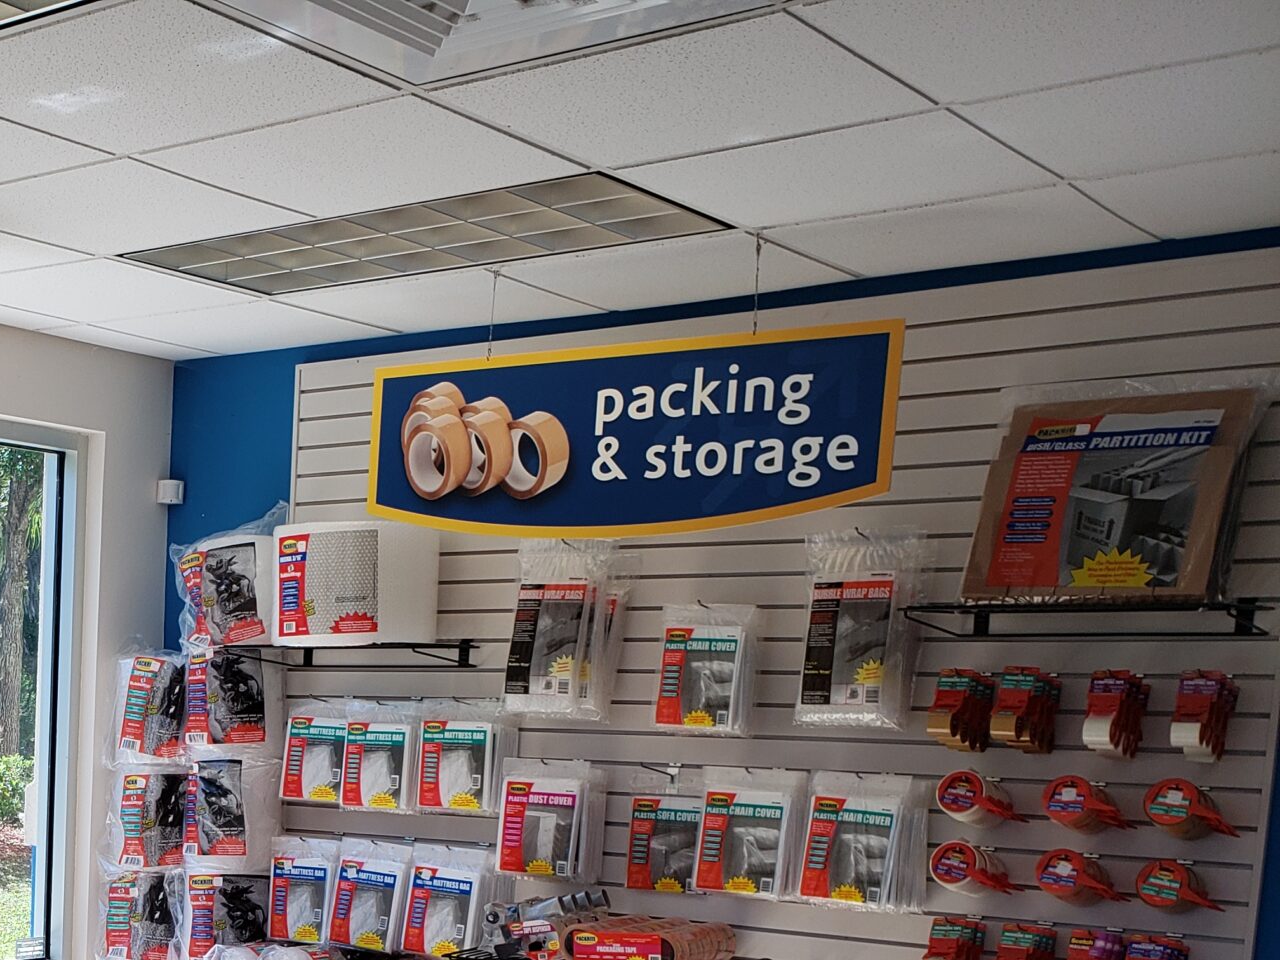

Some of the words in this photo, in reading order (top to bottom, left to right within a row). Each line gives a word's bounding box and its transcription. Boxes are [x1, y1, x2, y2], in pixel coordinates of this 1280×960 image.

[595, 364, 814, 436] packing
[1089, 432, 1177, 449] PARTITION
[1179, 430, 1211, 444] KIT
[591, 436, 628, 481] &
[644, 435, 859, 487] storage
[544, 590, 565, 600] WRAP
[565, 590, 584, 599] BAGS
[843, 587, 868, 599] WRAP
[868, 587, 890, 599] BAGS
[686, 641, 710, 651] CHAIR
[711, 641, 736, 652] COVER
[309, 728, 335, 736] MATTRESS
[366, 733, 392, 741] MATTRESS
[444, 731, 470, 739] MATTRESS
[529, 794, 548, 804] DUST
[549, 796, 572, 805] COVER
[657, 810, 675, 820] SOFA
[707, 806, 728, 814] PLASTIC
[729, 806, 753, 816] CHAIR
[755, 807, 781, 818] COVER
[813, 812, 837, 820] PLASTIC
[838, 812, 862, 823] CHAIR
[863, 813, 891, 826] COVER
[291, 868, 314, 876] MATTRESS
[358, 872, 384, 882] MATTRESS
[384, 876, 395, 884] BAG
[433, 879, 459, 889] MATTRESS
[460, 882, 471, 891] BAG
[1070, 938, 1094, 946] Scotch
[596, 945, 625, 953] PACKAGING
